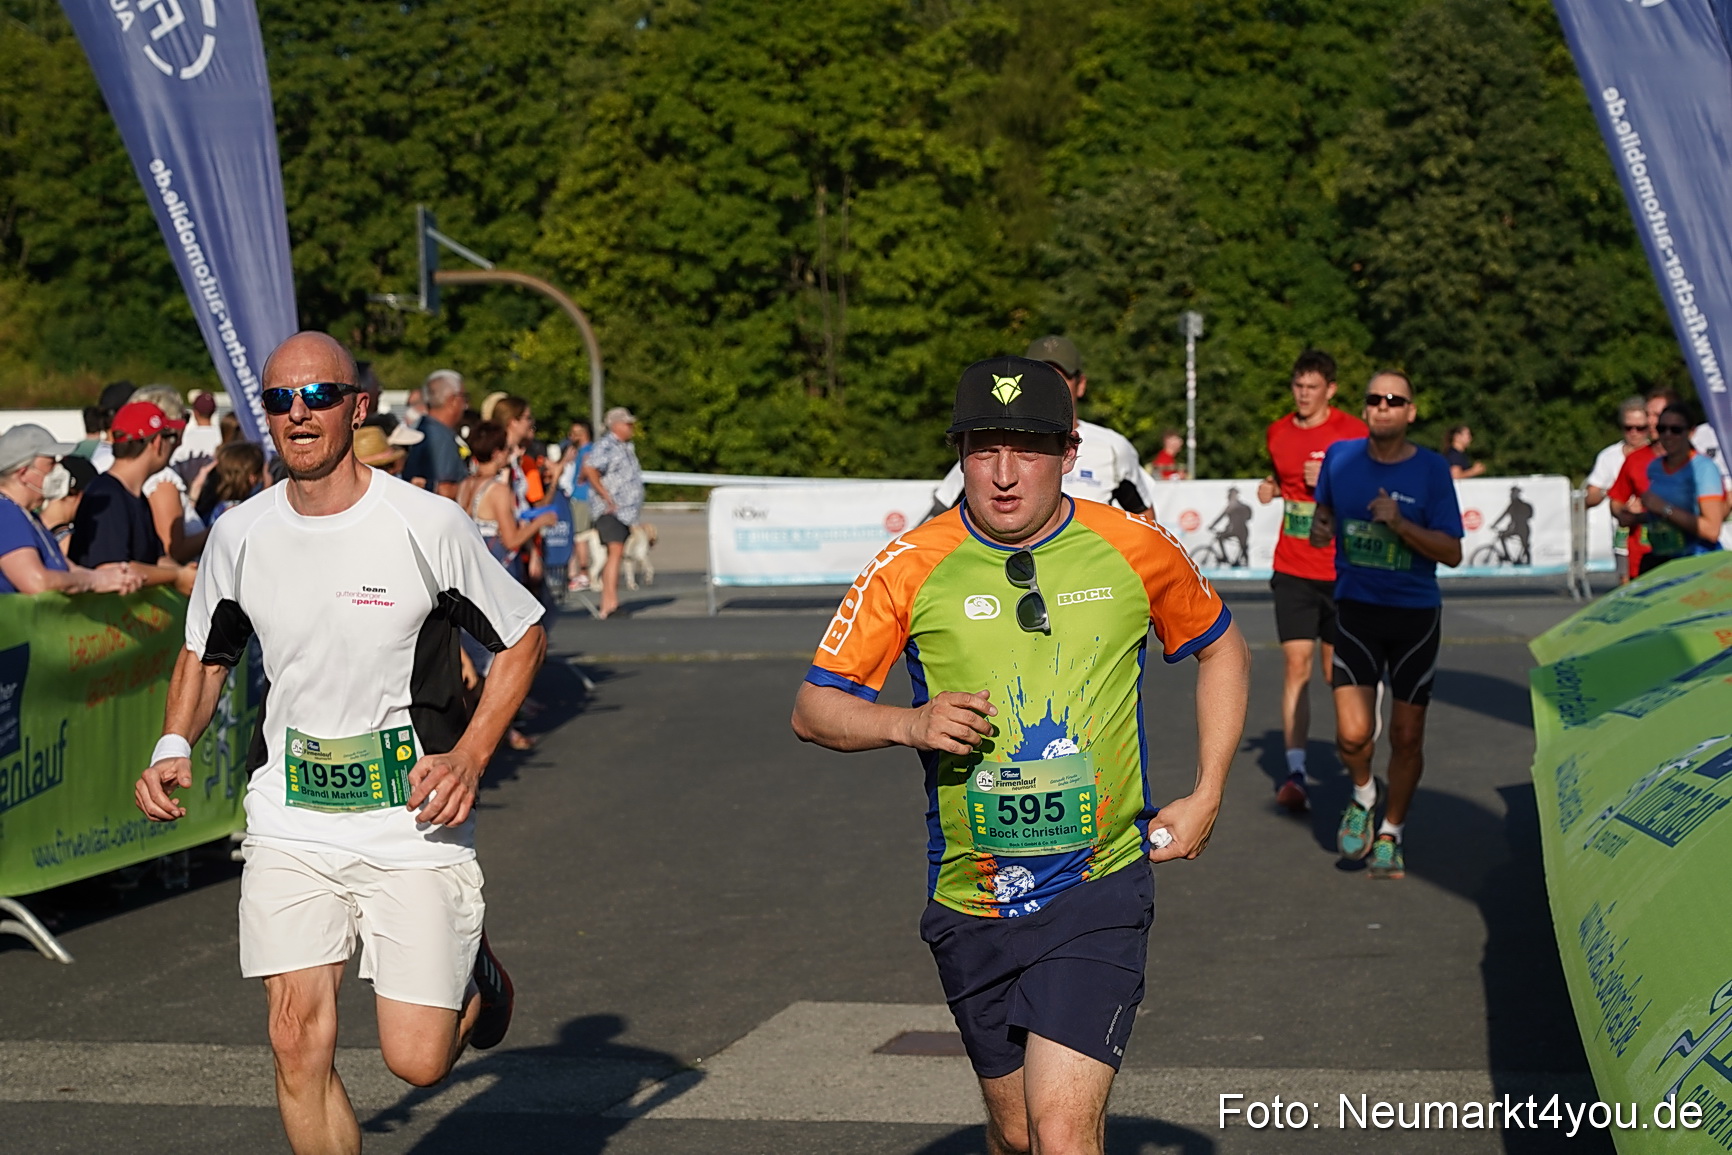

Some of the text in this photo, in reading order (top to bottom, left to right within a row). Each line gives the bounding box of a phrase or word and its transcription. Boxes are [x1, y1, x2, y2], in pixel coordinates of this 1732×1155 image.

[1353, 536, 1384, 551] 449
[1057, 586, 1114, 606] BOCK
[289, 765, 299, 792] RUN
[299, 760, 367, 789] 1959
[369, 763, 383, 799] 2022
[995, 777, 1037, 788] Firmenlauf
[301, 786, 369, 799] Brandl Markus
[973, 803, 986, 835] RUN
[997, 792, 1065, 825] 595
[1079, 791, 1092, 835] 2022
[989, 825, 1078, 839] Bock Christian
